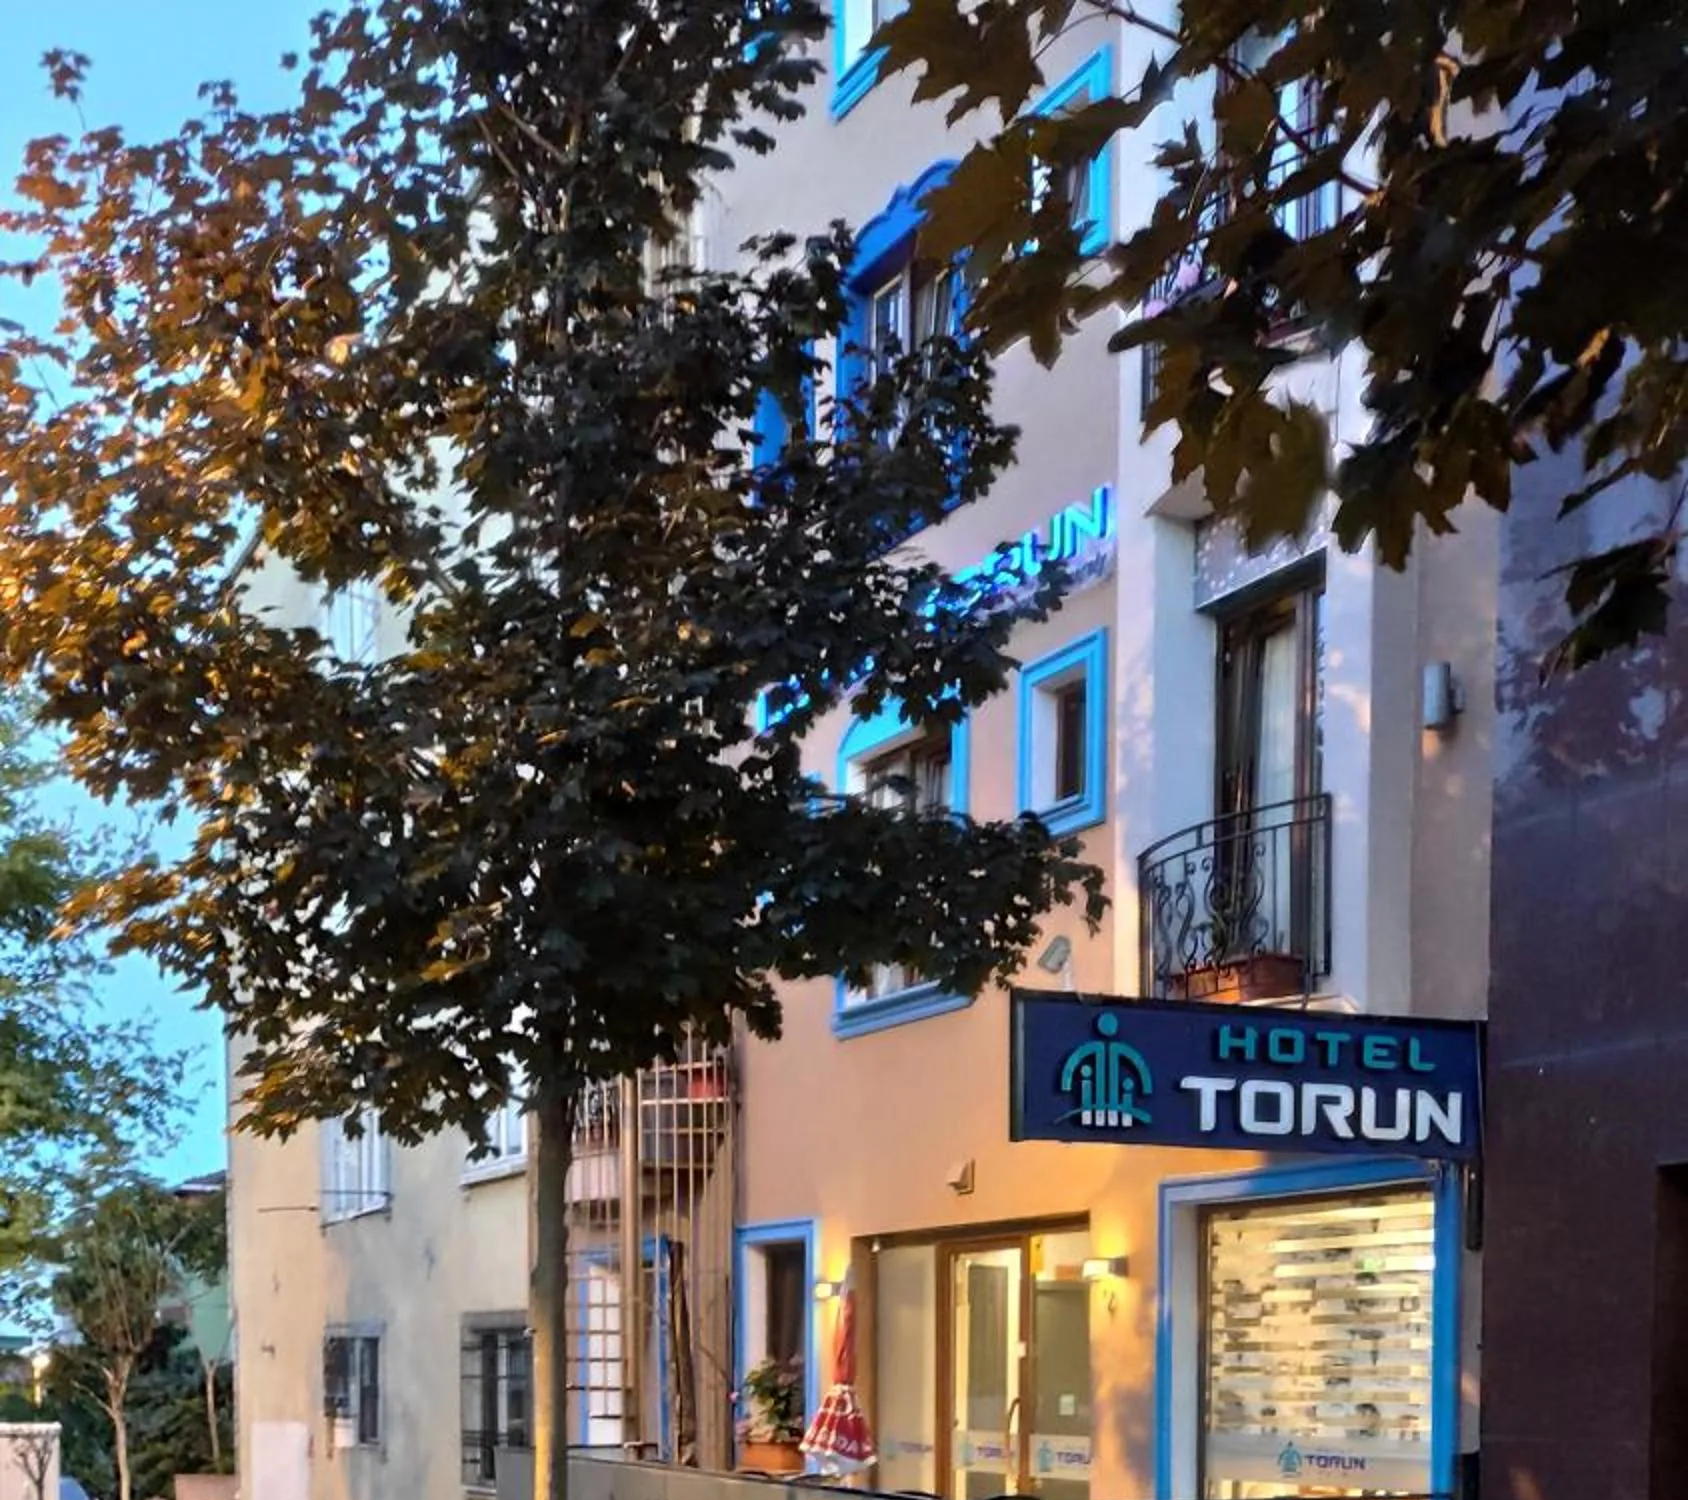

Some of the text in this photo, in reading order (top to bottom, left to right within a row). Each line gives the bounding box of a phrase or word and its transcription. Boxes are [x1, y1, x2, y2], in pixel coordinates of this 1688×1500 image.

[1217, 1023, 1436, 1072] HOTEL
[1180, 1075, 1462, 1145] TORUN
[1304, 1454, 1366, 1471] TORUN
